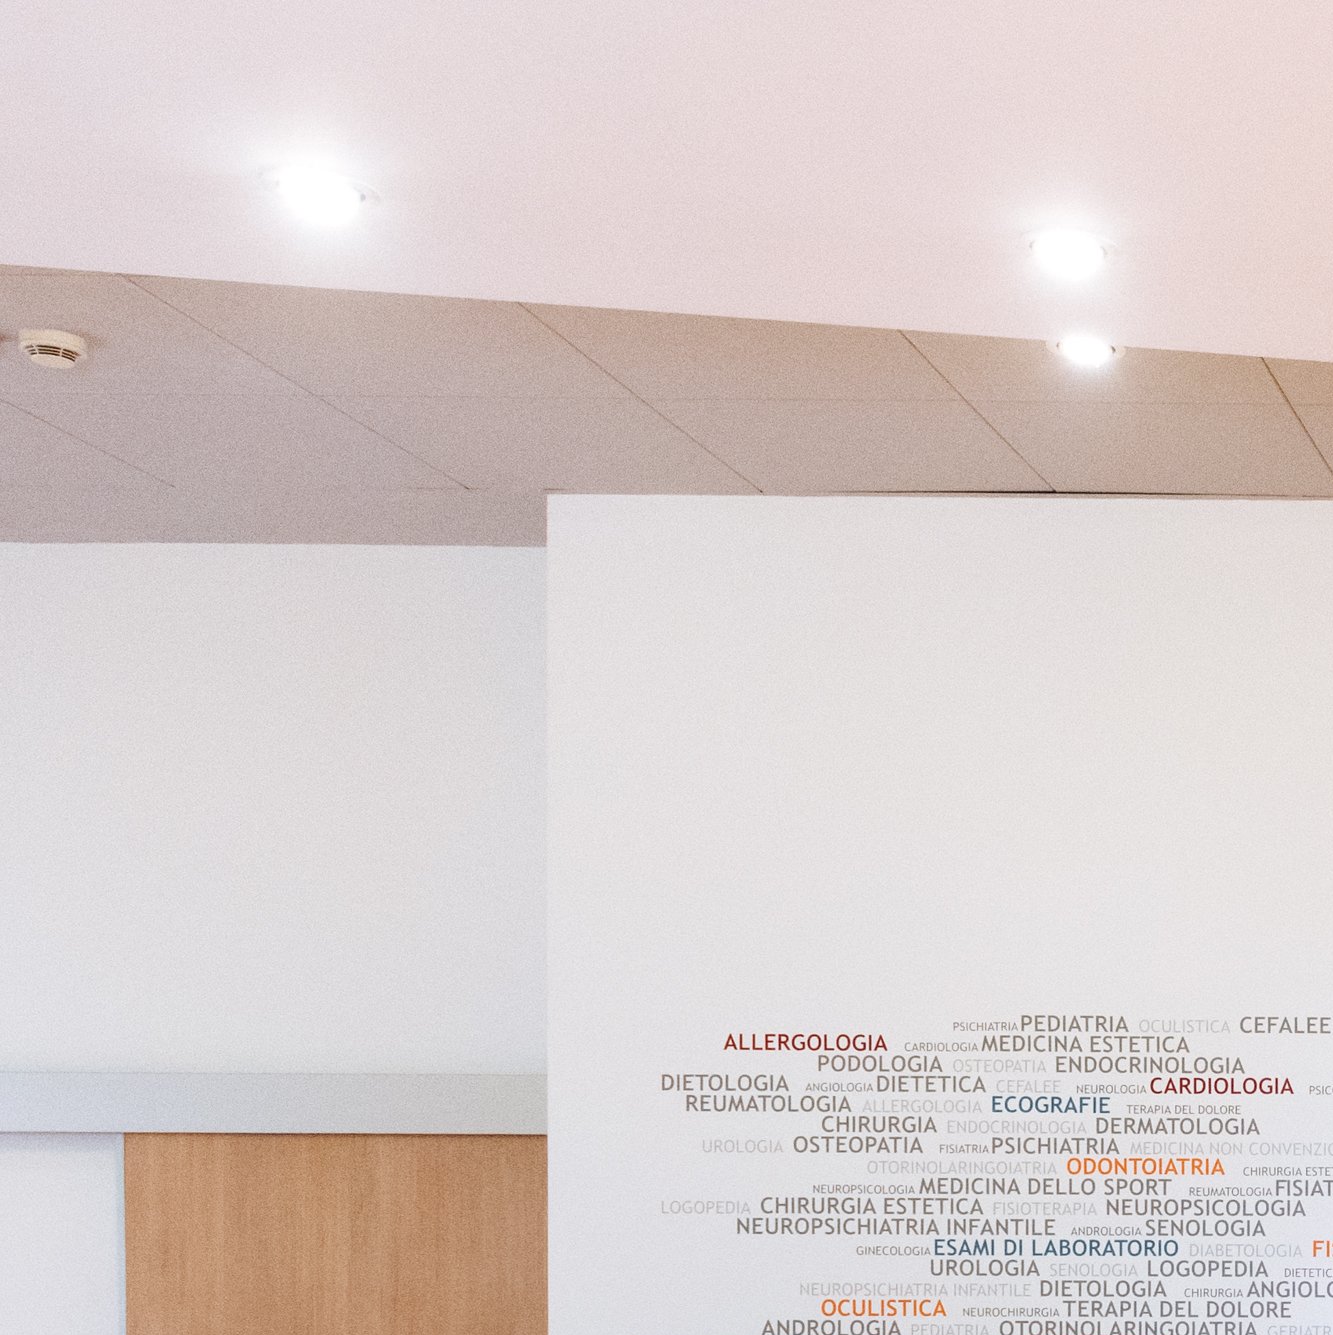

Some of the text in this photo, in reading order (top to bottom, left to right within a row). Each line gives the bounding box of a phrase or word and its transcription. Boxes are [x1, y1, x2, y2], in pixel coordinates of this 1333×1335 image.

[953, 1015, 1331, 1034] PSICHIATRIA PEDIATRIA OCULISTICA CEFALEE
[724, 1034, 1189, 1053] ALLERGOLOGIA CARDIOLOGIA MEDICINA ESTETICA
[818, 1055, 1245, 1074] PODOLOGIA OSTEOPATIA ENDOCRINOLOGIA
[662, 1074, 788, 1091] DIETOLOGIA
[805, 1082, 873, 1092] ANGIOLOGIA
[877, 1076, 986, 1093] DIETETICA
[996, 1080, 1061, 1093] CEFALEE
[1077, 1084, 1147, 1094] NEUROLOGIA
[1150, 1078, 1293, 1095] CARDIOLOGIA
[686, 1095, 1241, 1115] REUMATOLOGIA ALLERGOLOGIA ECOGRAFIE TERAPIA DEL DOLORE
[822, 1116, 1260, 1135] CHIRURGIA ENDOCRINOLOGIA DERMATOLOGIA
[703, 1139, 782, 1153] UROLOGIA
[793, 1137, 923, 1154] OSTEOPATIA
[940, 1144, 989, 1154] FISIATRIA
[993, 1138, 1119, 1155] PSICHIATRIA
[1130, 1141, 1206, 1155] MEDICINA
[1210, 1141, 1243, 1156] NON
[867, 1160, 1056, 1175] OTORINOLARINGOIATRIA
[1067, 1158, 1224, 1176] ODONTOIATRIA
[1243, 1166, 1302, 1176] CHIRURGIA
[813, 1184, 915, 1195] NEUROPSICOLOGIA
[920, 1178, 1020, 1195] MEDICINA
[1029, 1179, 1095, 1195] DELLO
[1104, 1180, 1171, 1196] SPORT
[1189, 1186, 1272, 1197] REUMATOLOGIA
[662, 1197, 1306, 1217] LOGOPEDIA CHIRURGIA ESTETICA FISIOTERAPIA NEUROPSICOLOGIA
[738, 1218, 1265, 1237] NEUROPSICHIATRIA INFANTILE ANDROLOGIA SENOLOGIA
[856, 1245, 931, 1256] GINECOLOGIA
[935, 1239, 995, 1256] ESAMI
[1004, 1240, 1023, 1256] DI
[1032, 1240, 1178, 1257] LABORATORIO
[1189, 1244, 1302, 1258] DIABETOLOGIA
[931, 1260, 1039, 1277] UROLOGIA
[1049, 1263, 1138, 1277] SENOLOGIA
[1148, 1260, 1268, 1278] LOGOPEDIA
[800, 1283, 948, 1297] NEUROPSICHIATRIA
[954, 1284, 1031, 1297] INFANTILE
[1041, 1280, 1167, 1298] DIETOLOGIA
[1184, 1288, 1243, 1298] CHIRURGIA
[821, 1299, 1291, 1319] OCULISTICA NEUROCHIRURGIA TERAPIA DEL DOLORE
